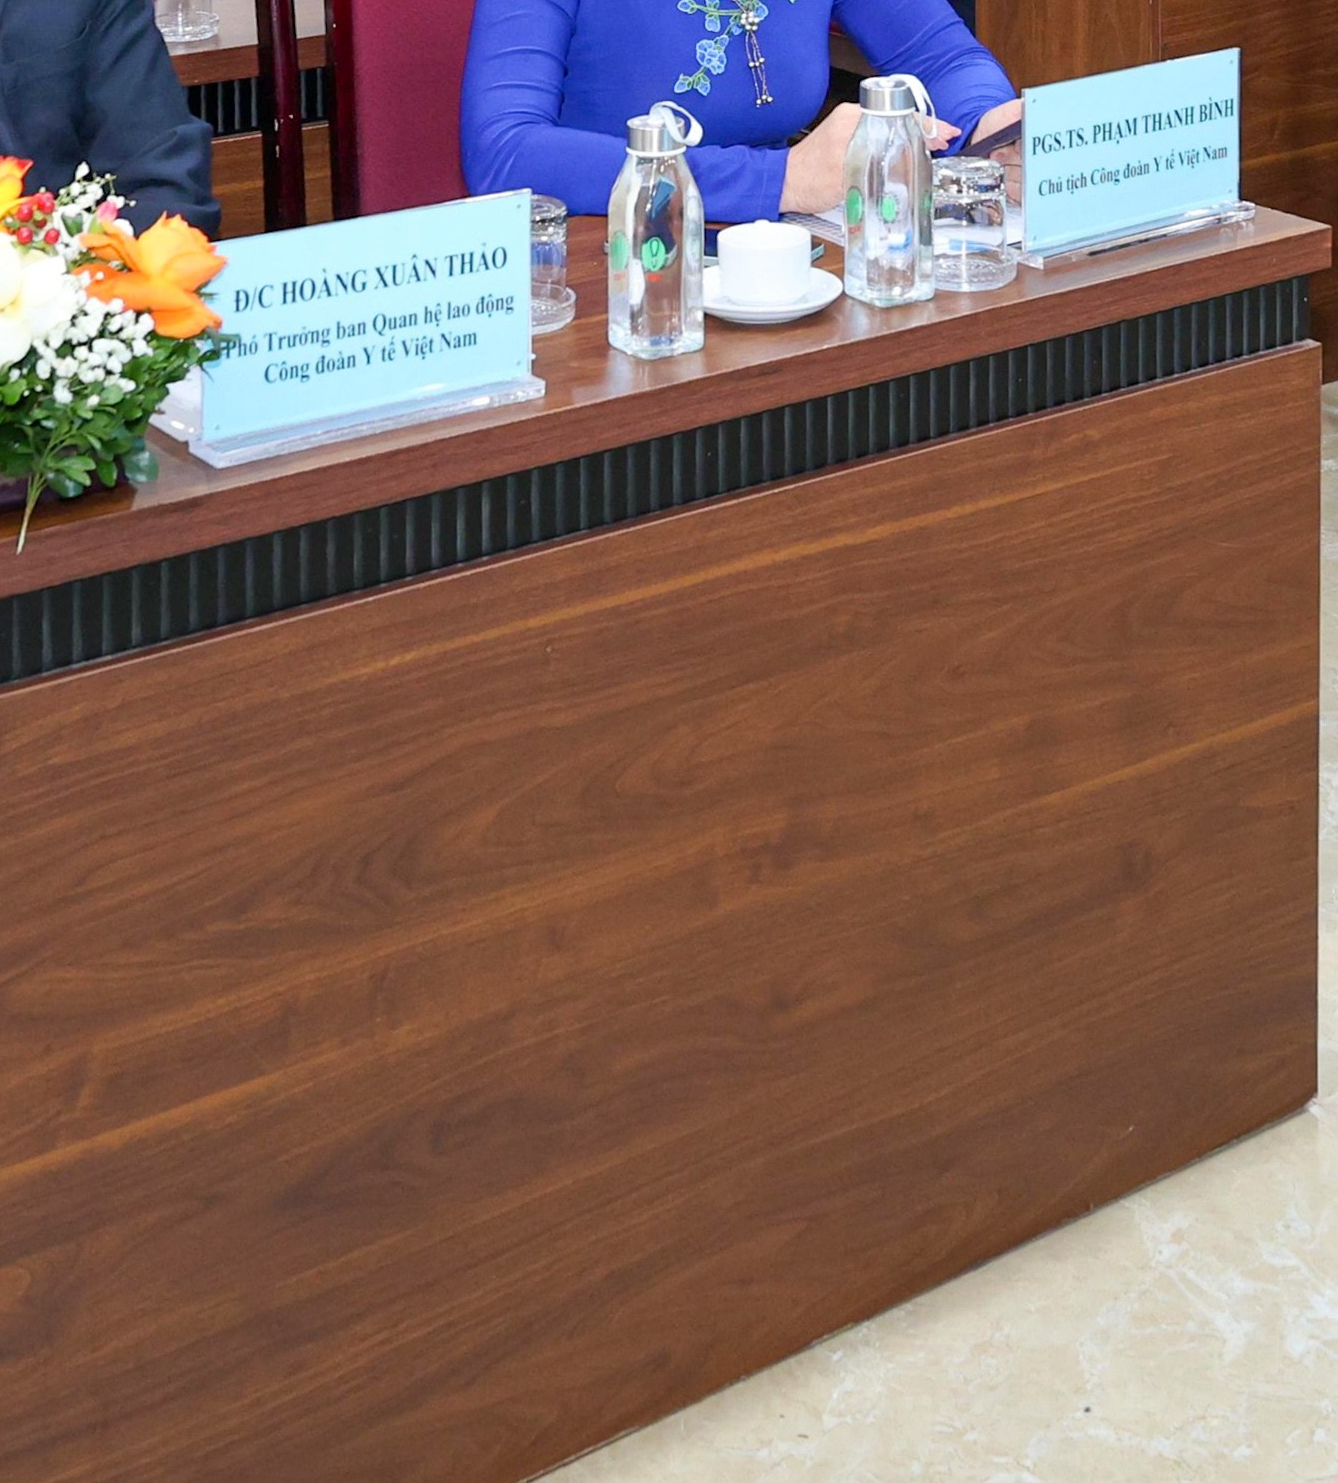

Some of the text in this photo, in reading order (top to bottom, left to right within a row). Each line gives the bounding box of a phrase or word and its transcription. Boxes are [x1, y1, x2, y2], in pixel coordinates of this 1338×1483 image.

[1031, 96, 1234, 156] PGS.TS. PHẠM THANH BÌNH
[1038, 145, 1228, 196] Chủ tịch Công đoàn Y tế Việt Nam
[233, 242, 508, 313] Đ/C HOÀNG XUÂN THẢO
[224, 293, 515, 360] Phó Trưởng ban Quan hệ lao động
[264, 331, 478, 384] Công đoàn Y tế Việt Nam
